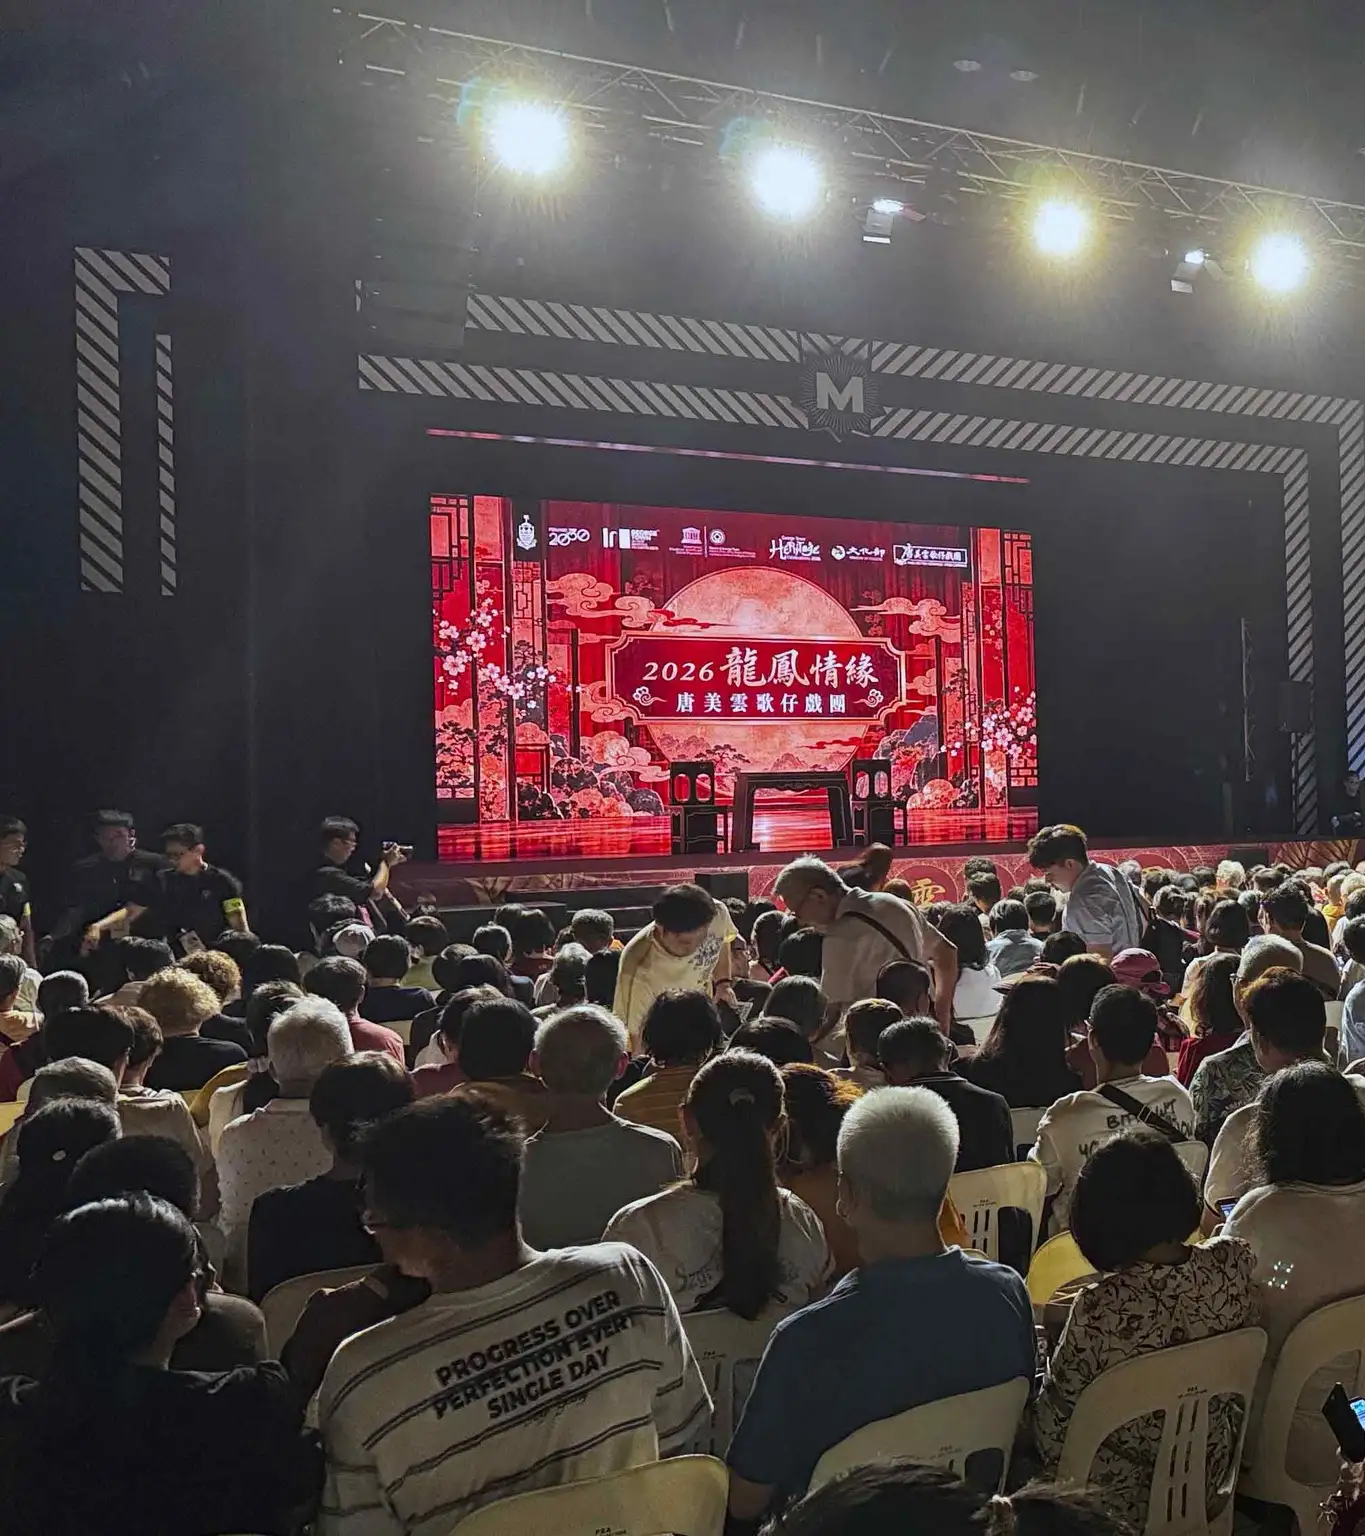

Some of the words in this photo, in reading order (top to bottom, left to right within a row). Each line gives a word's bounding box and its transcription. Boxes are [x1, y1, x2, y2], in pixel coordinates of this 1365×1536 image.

[816, 371, 864, 414] M
[642, 662, 714, 681] 2026
[719, 646, 880, 689] 龍鳳情緣
[675, 691, 847, 714] 唐美雲歌仔戲團
[435, 1319, 560, 1387] PROGRESS
[564, 1290, 621, 1329] OVER
[433, 1337, 572, 1420] PERFECTION
[487, 1368, 565, 1419] SINGLE
[567, 1346, 611, 1382] DAY
